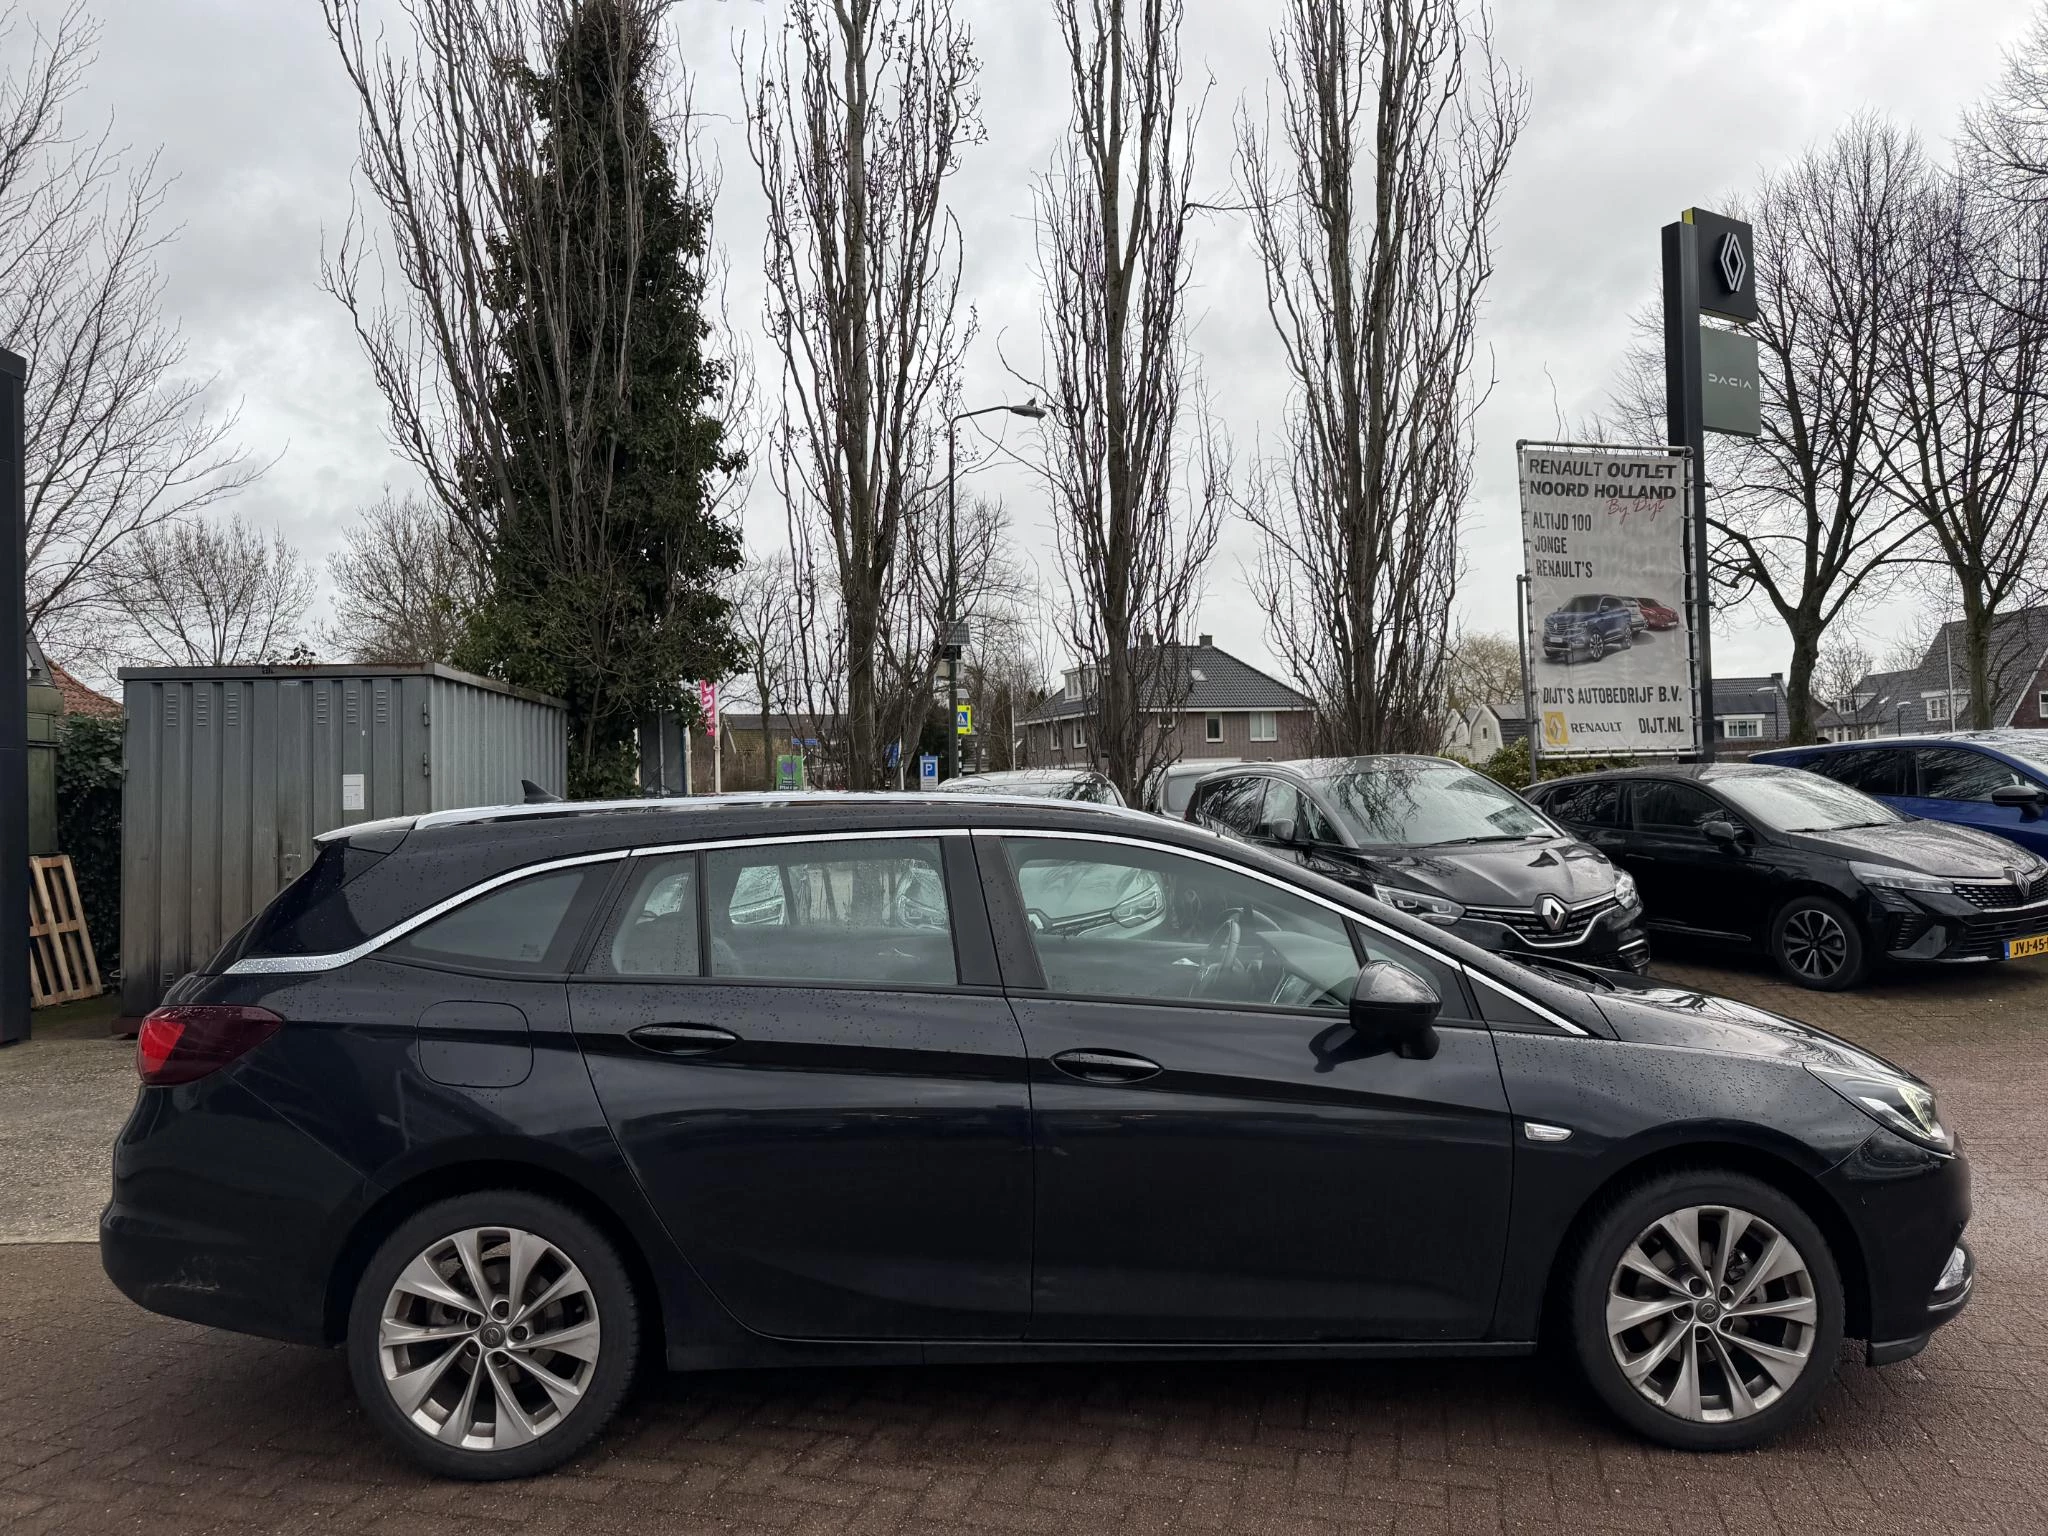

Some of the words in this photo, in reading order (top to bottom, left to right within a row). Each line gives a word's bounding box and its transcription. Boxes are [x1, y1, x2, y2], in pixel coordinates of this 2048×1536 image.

[1708, 373, 1752, 389] DACIA
[1529, 459, 1603, 477] RENAULT
[1607, 462, 1677, 479] OUTLET
[1530, 481, 1589, 498] NOORD
[1594, 484, 1677, 499] HOLLAND
[1606, 499, 1630, 525] By
[1532, 512, 1569, 531] ALTIJD
[1572, 514, 1592, 531] 100
[1534, 536, 1567, 554] JONGE
[1536, 559, 1593, 578] RENAULT'S
[1543, 687, 1574, 704] DIJT'S
[1577, 686, 1654, 704] AUTOBEDRIJF
[1658, 686, 1682, 703] B.V.
[1570, 721, 1623, 734] RENAULT
[1638, 716, 1684, 734] DIJT.NL
[925, 763, 933, 776] P
